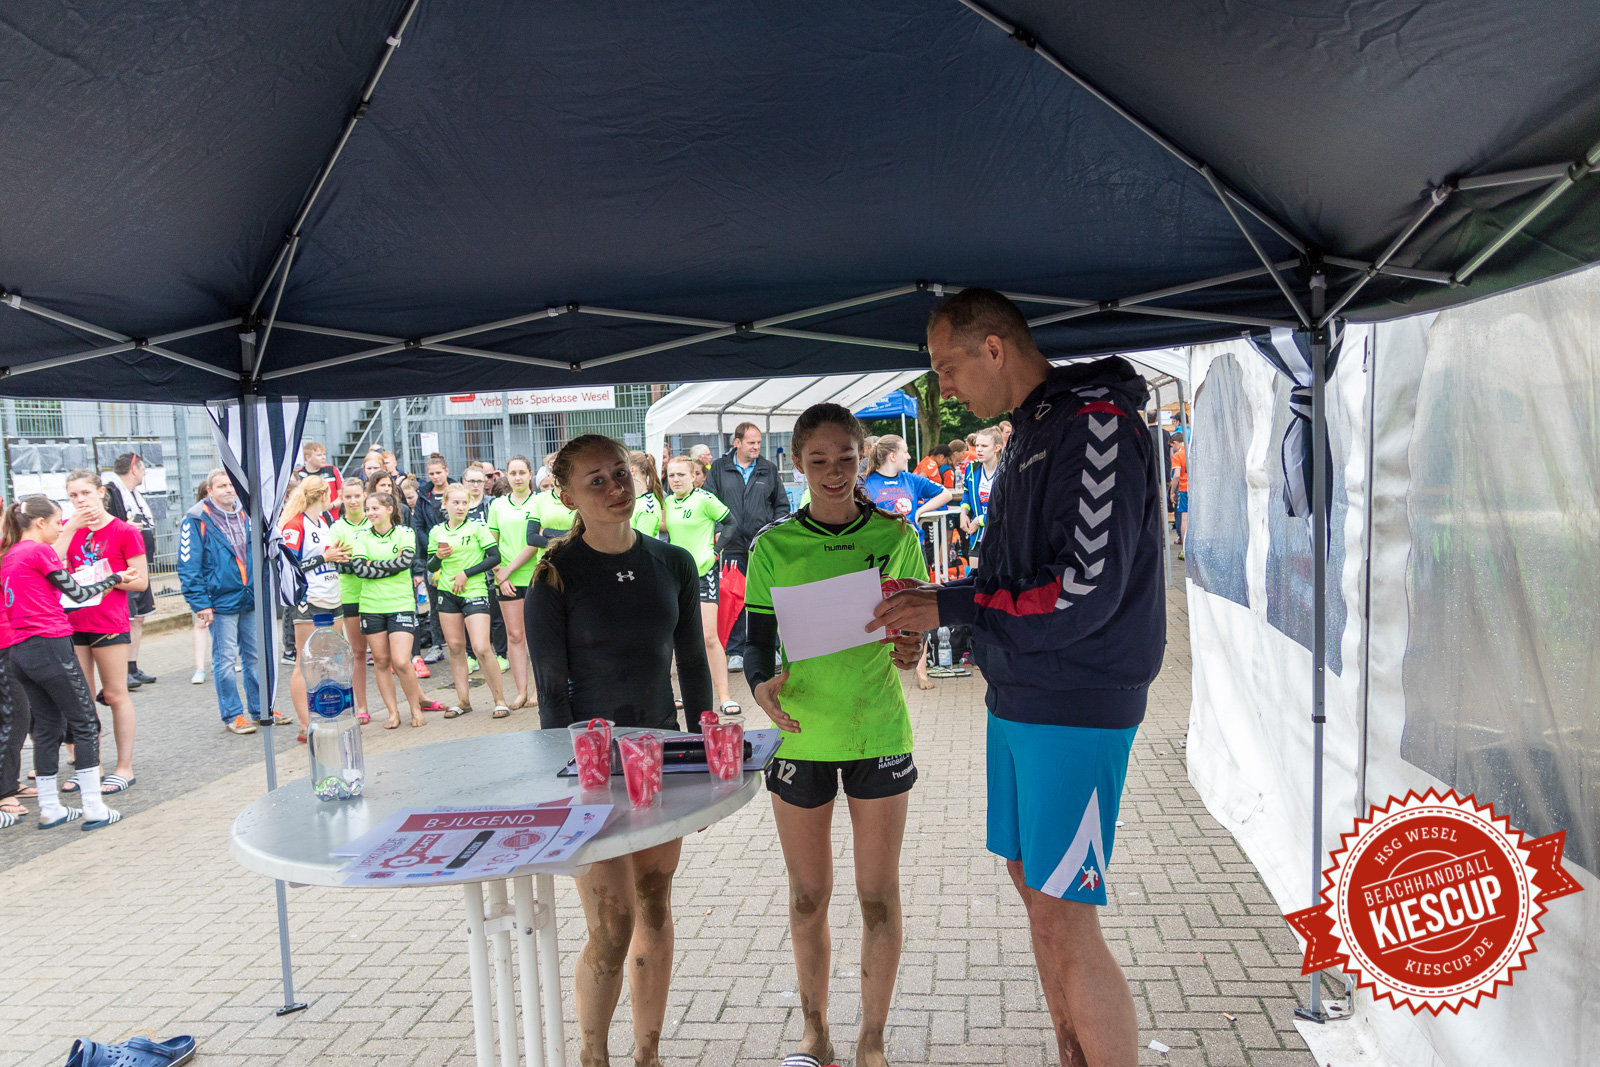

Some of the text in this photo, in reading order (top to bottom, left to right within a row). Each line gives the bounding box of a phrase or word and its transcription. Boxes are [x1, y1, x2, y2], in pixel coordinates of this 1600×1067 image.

[481, 391, 609, 406] Verbnds-Sparkasse Wesel
[311, 532, 320, 544] 8
[461, 535, 471, 545] 17
[392, 544, 399, 554] 6
[823, 543, 855, 552] hummel
[3, 576, 14, 607] 6
[777, 760, 797, 785] 12
[423, 814, 536, 829] B-JUGEND
[411, 834, 438, 853] PLATZ
